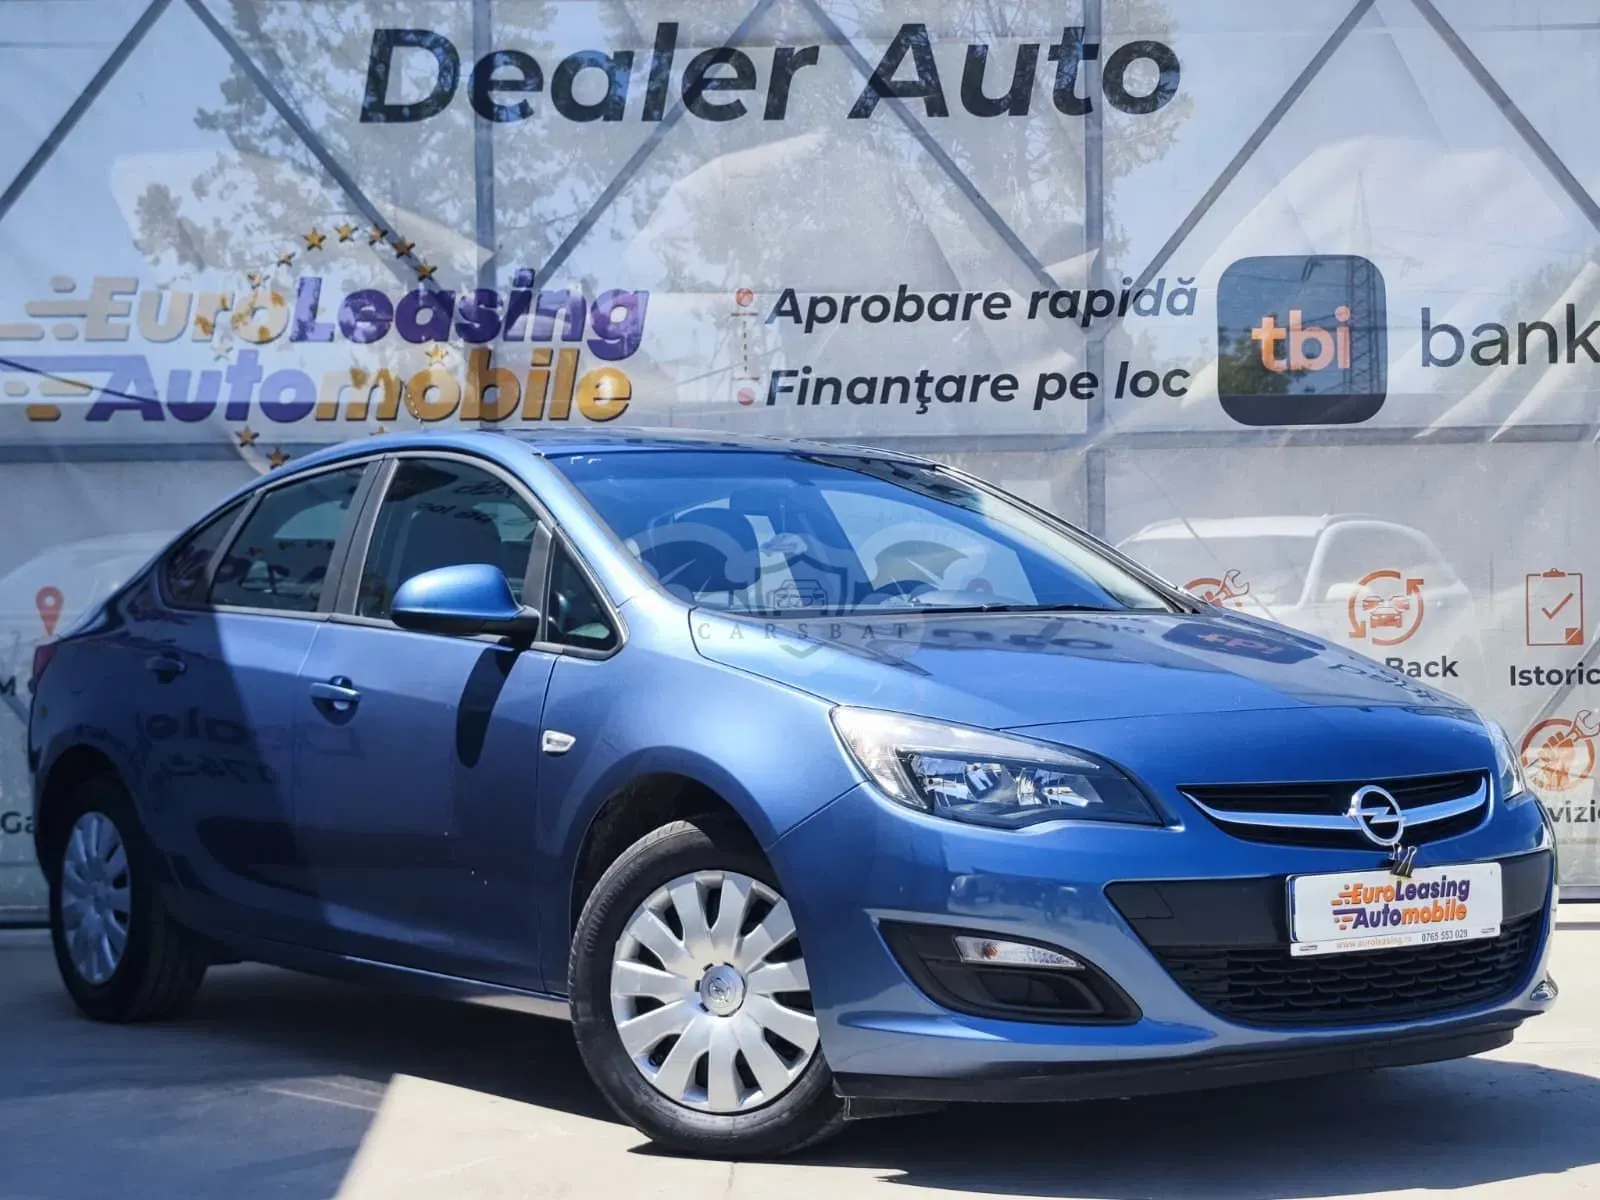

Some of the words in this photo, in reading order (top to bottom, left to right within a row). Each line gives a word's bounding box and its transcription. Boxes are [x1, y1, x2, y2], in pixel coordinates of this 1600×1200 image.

[359, 22, 820, 124] Dealer
[847, 23, 1183, 119] Auto
[84, 267, 650, 361] EuroLeasing
[765, 284, 1012, 333] Aprobare
[1028, 277, 1198, 327] rapidă
[1251, 305, 1351, 372] tbi
[1421, 303, 1600, 367] bank
[85, 346, 634, 422] Automobile
[1033, 371, 1099, 410] pe
[1115, 361, 1191, 399] loc
[1385, 656, 1459, 678] Back
[1547, 800, 1600, 823] vizi
[1351, 875, 1470, 904] EuroLeasing
[1352, 898, 1467, 929] Automobile
[1422, 932, 1439, 942] 0765
